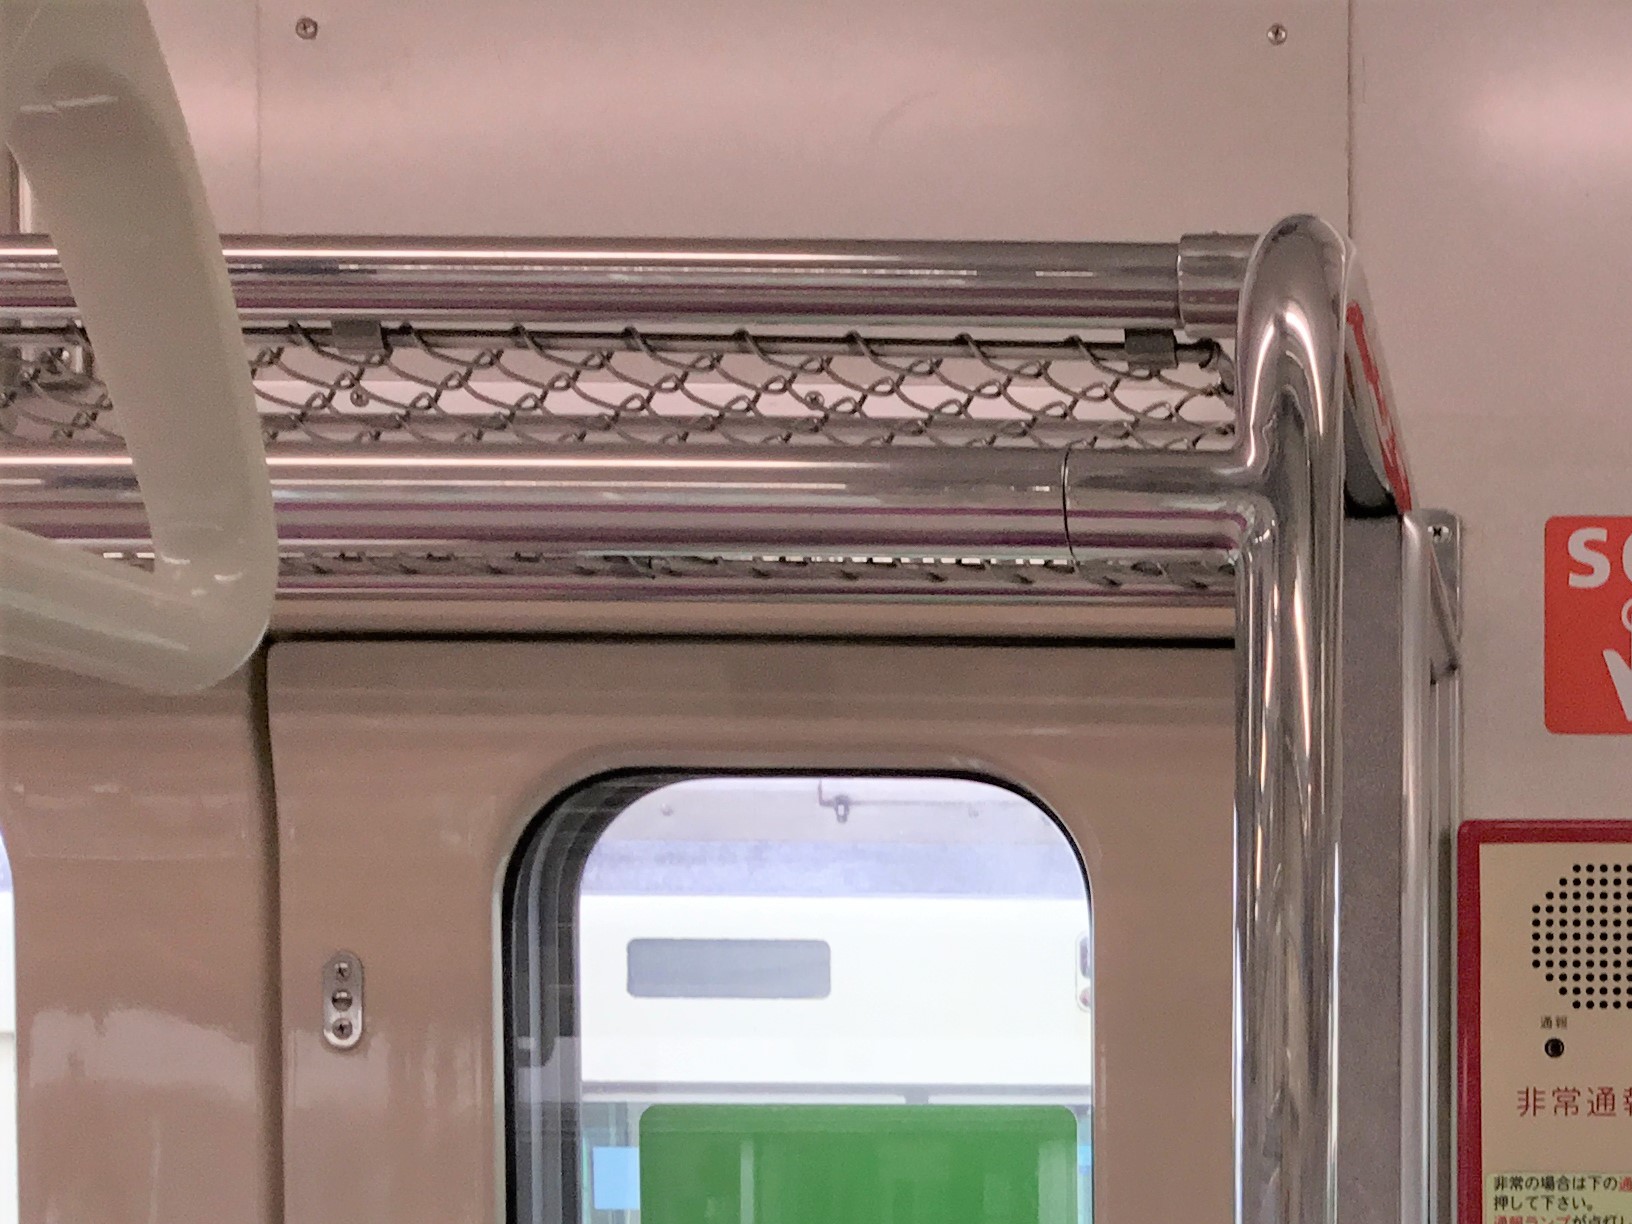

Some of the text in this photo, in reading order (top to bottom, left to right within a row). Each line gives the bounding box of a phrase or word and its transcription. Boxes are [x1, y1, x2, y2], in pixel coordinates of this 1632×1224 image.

[1540, 1015, 1568, 1029] 通報
[1493, 1195, 1594, 1211] 押して下さい。
